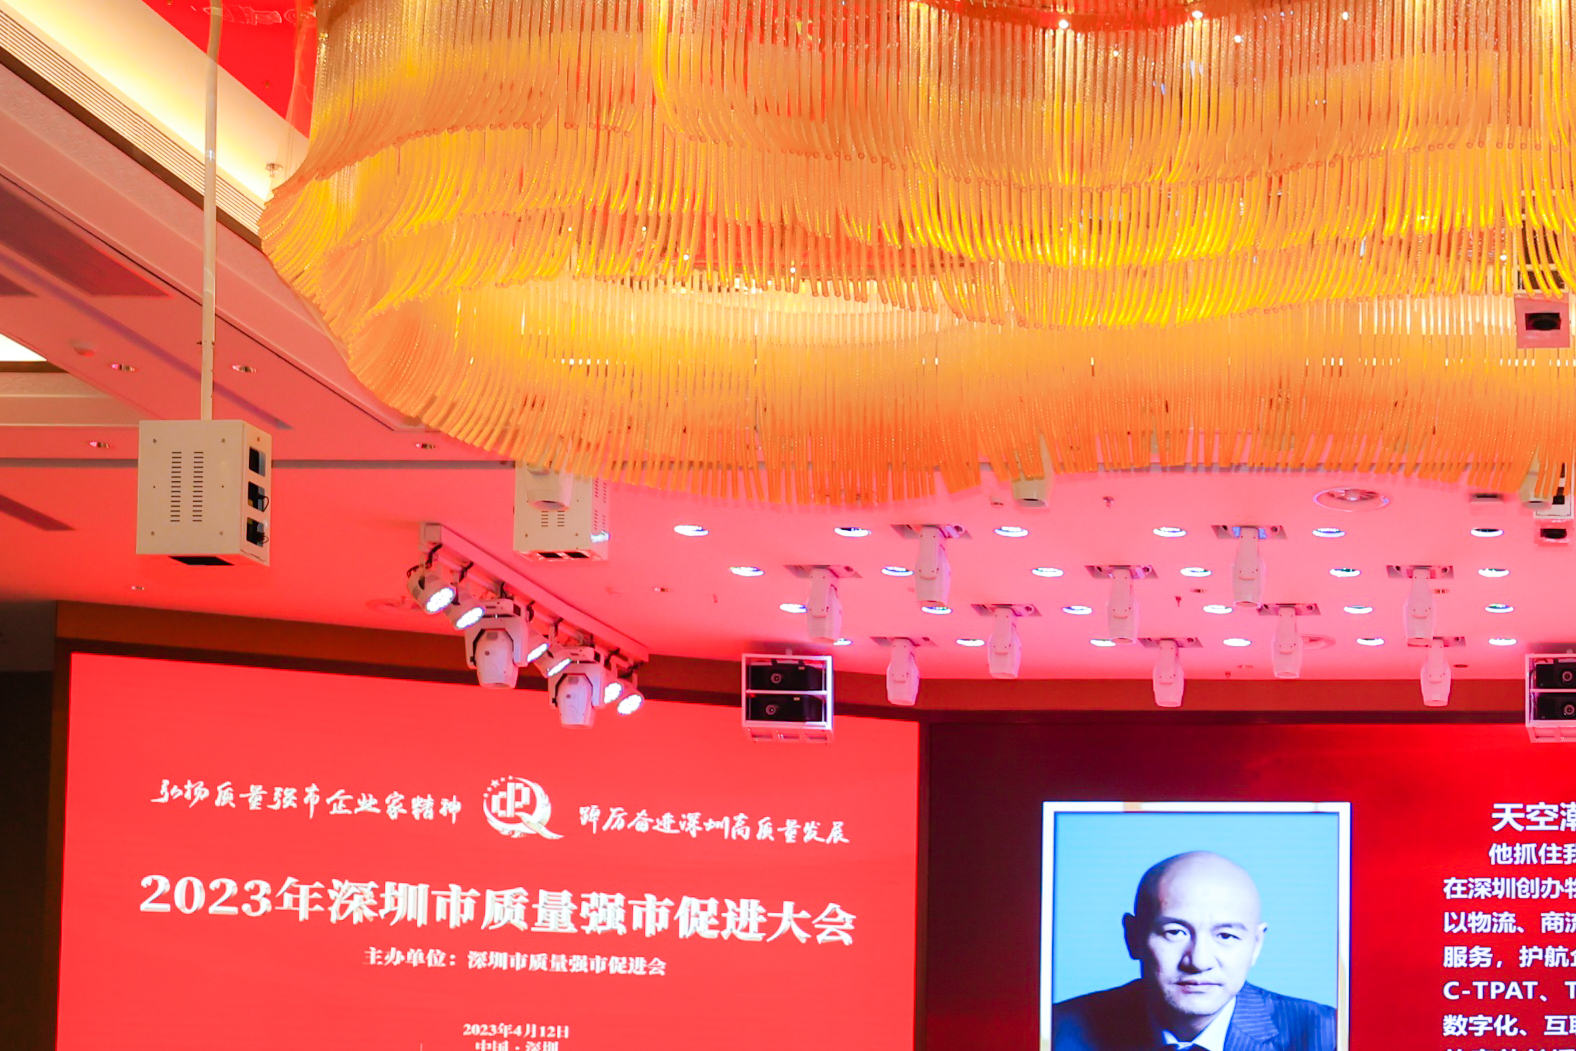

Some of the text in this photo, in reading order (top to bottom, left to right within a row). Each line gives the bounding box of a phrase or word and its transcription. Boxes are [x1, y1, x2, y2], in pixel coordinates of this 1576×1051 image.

[139, 874, 857, 946] 2023年深圳市质量强市促进大会
[364, 947, 667, 977] 主办单位：深圳市质量强市促进会
[462, 1023, 570, 1039] 2023年4月12日
